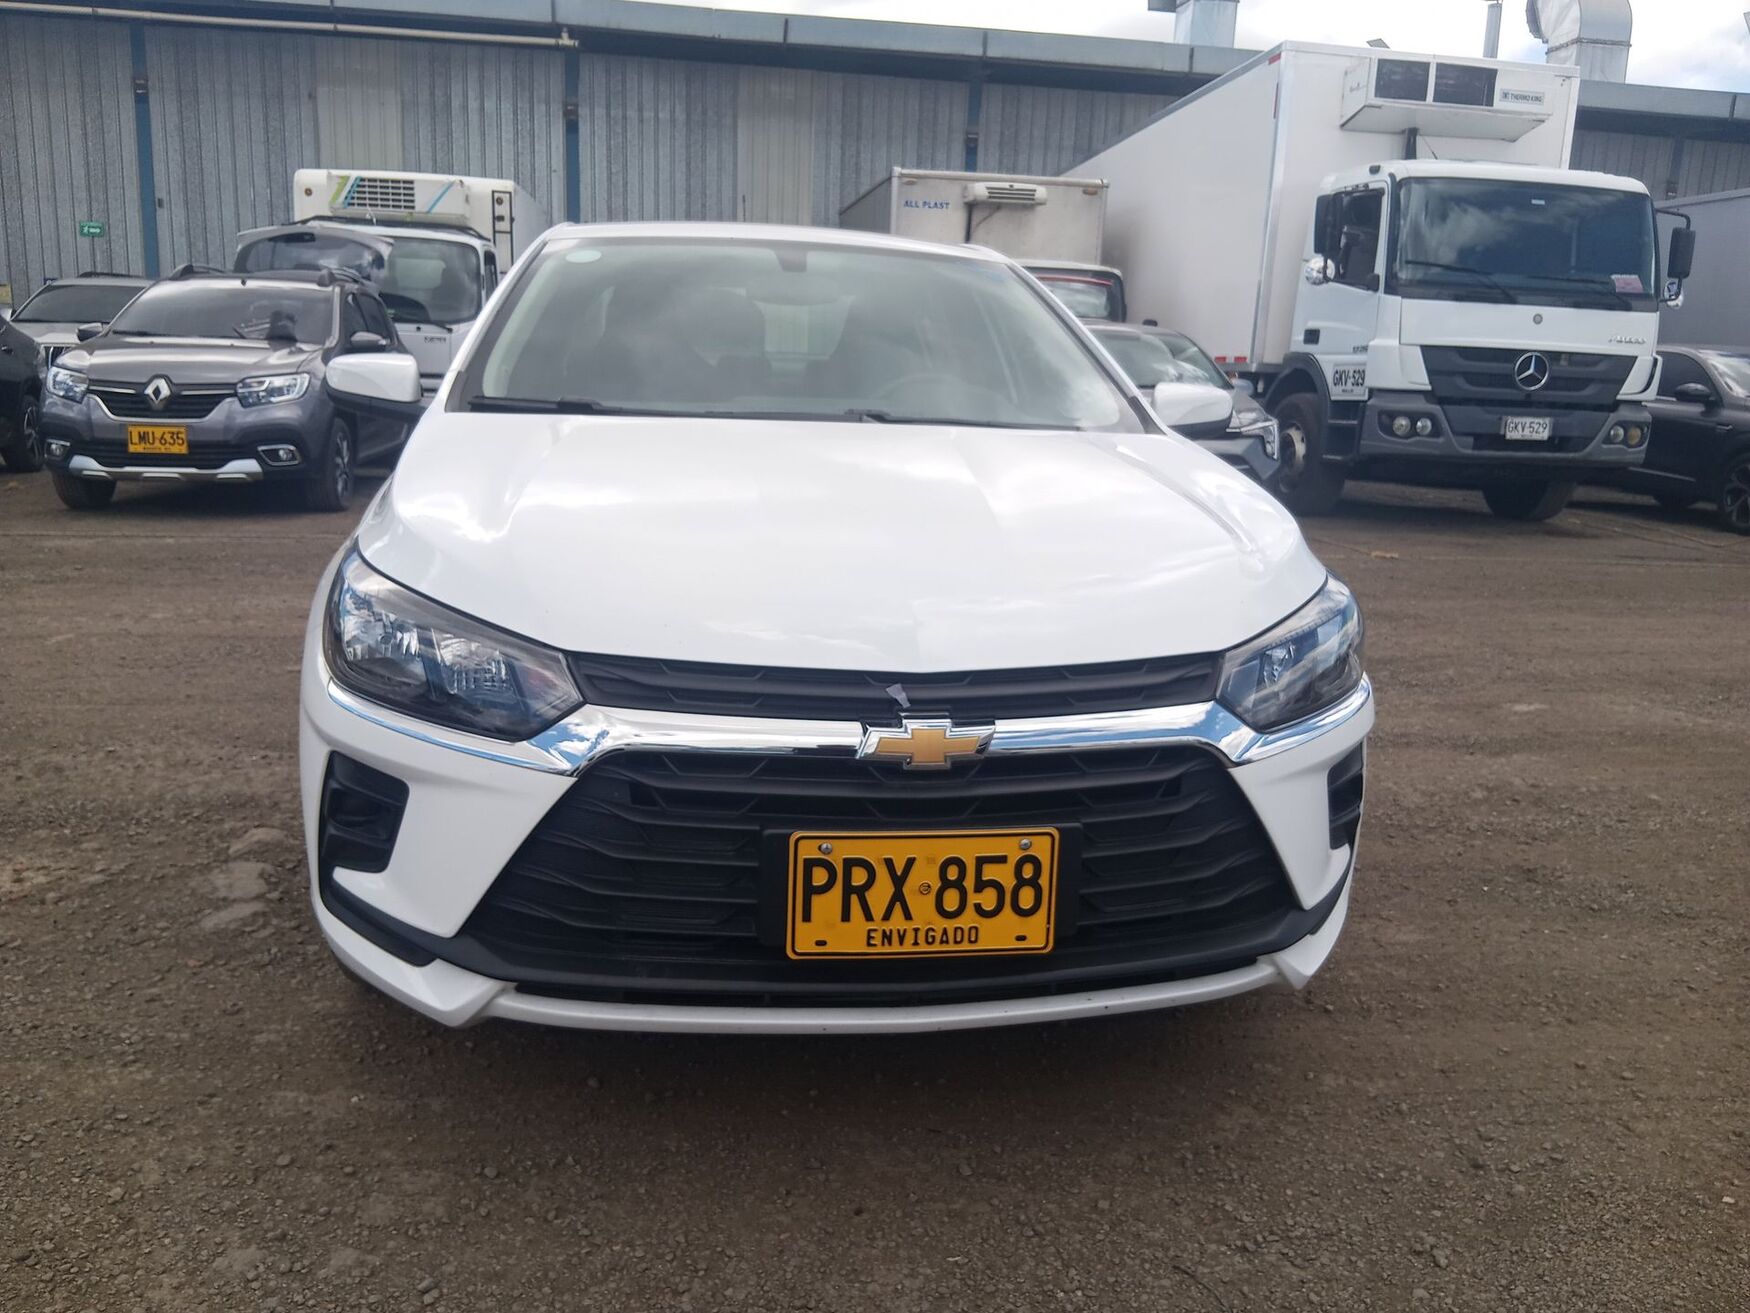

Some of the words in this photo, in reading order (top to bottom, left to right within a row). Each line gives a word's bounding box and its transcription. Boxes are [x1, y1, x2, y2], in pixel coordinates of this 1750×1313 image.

[903, 200, 920, 209] ALL
[921, 200, 950, 210] PLAST
[1528, 421, 1548, 434] 529
[129, 430, 155, 446] LMU
[159, 430, 185, 446] 635
[801, 856, 917, 923] PRX
[933, 853, 1043, 919] 858
[866, 925, 979, 947] ENVIGADO
